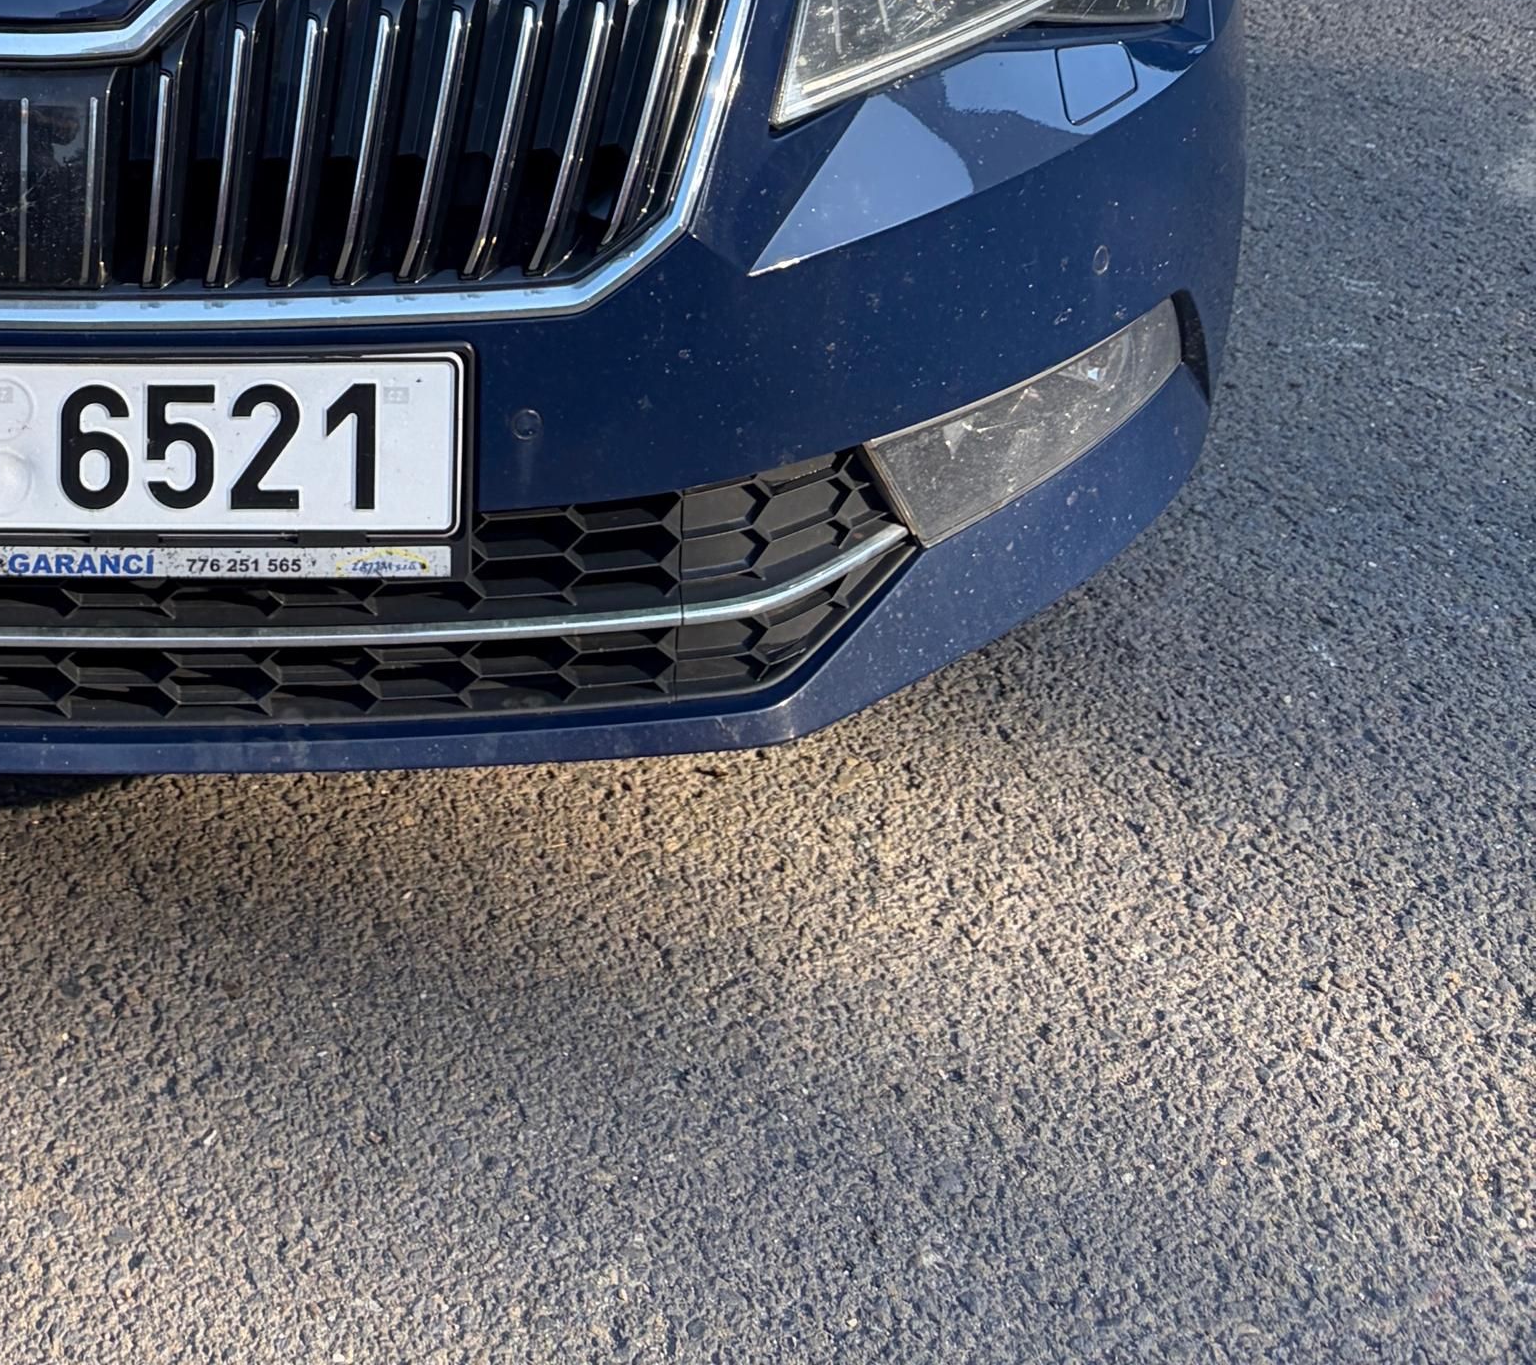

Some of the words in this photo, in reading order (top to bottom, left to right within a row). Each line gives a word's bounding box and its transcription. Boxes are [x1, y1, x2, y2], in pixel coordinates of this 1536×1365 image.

[61, 382, 377, 512] 6521
[8, 549, 155, 575] GARANCÍ
[186, 558, 221, 573] 776
[226, 558, 259, 573] 251
[267, 558, 302, 573] 565
